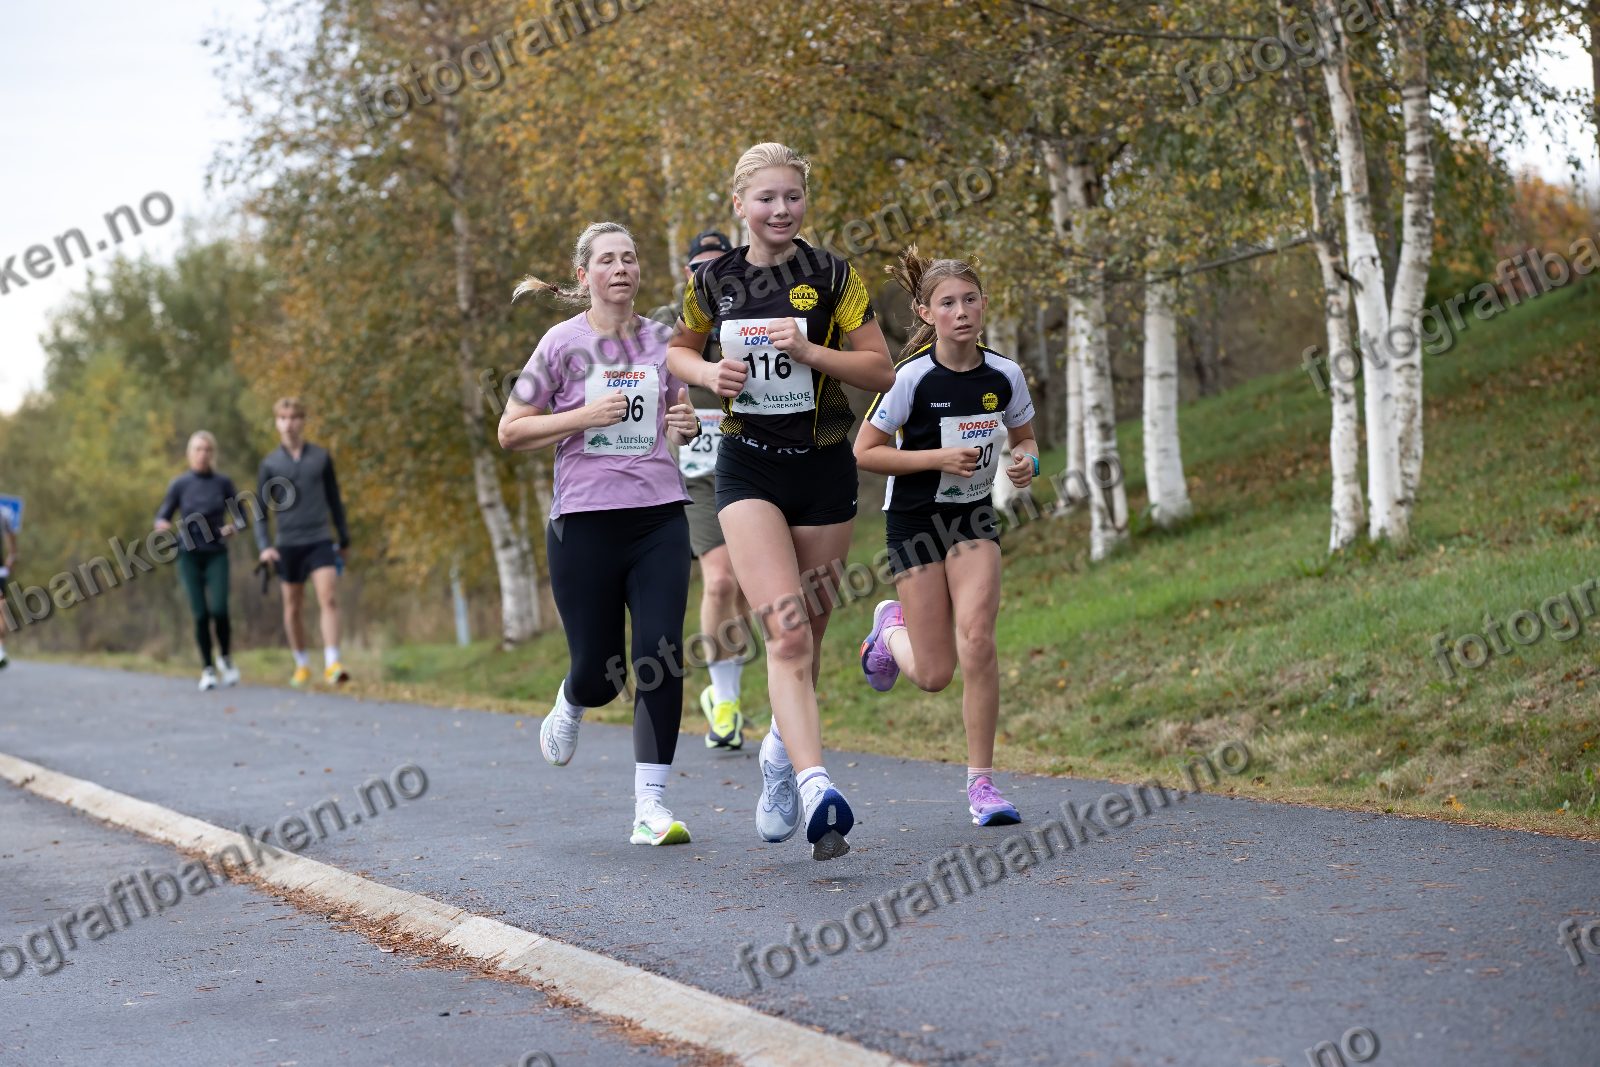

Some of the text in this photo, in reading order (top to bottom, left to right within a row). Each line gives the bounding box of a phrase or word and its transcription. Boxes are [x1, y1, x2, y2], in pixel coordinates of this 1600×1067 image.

[737, 326, 769, 336] NOR
[742, 352, 792, 380] 116
[603, 370, 646, 379] NORGES
[607, 379, 639, 388] LØPET
[763, 390, 811, 402] Aurskog
[958, 419, 999, 431] NORGES
[616, 434, 654, 446] Aurskog
[961, 428, 995, 440] LØPET
